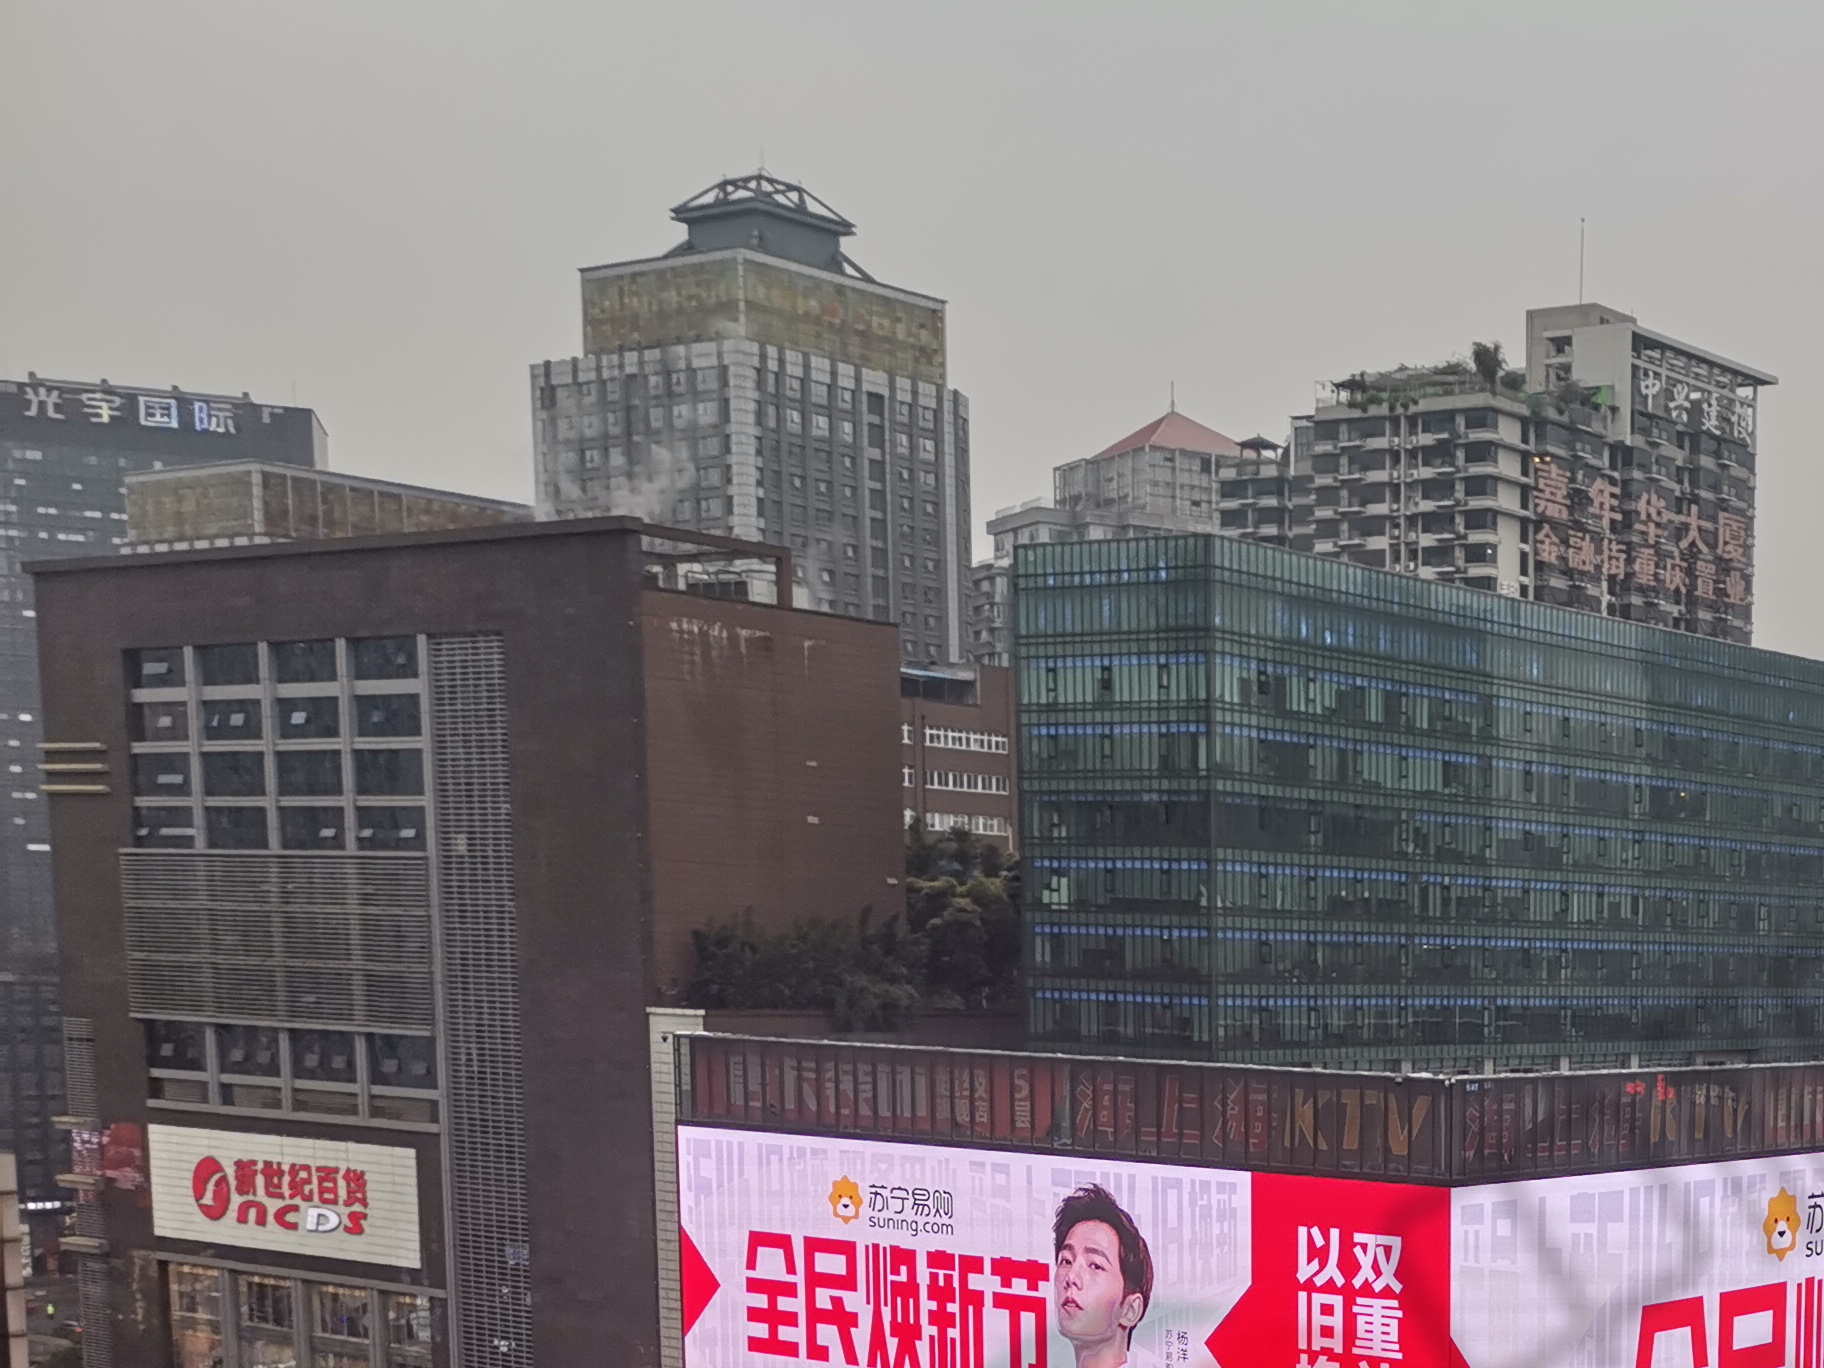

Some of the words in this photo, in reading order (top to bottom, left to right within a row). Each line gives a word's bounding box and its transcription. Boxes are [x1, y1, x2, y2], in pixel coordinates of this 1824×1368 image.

[1286, 1088, 1433, 1155] KTV
[234, 1158, 369, 1209] 新世纪百货
[868, 1182, 954, 1219] 苏宁易购
[868, 1214, 954, 1237] suning.com
